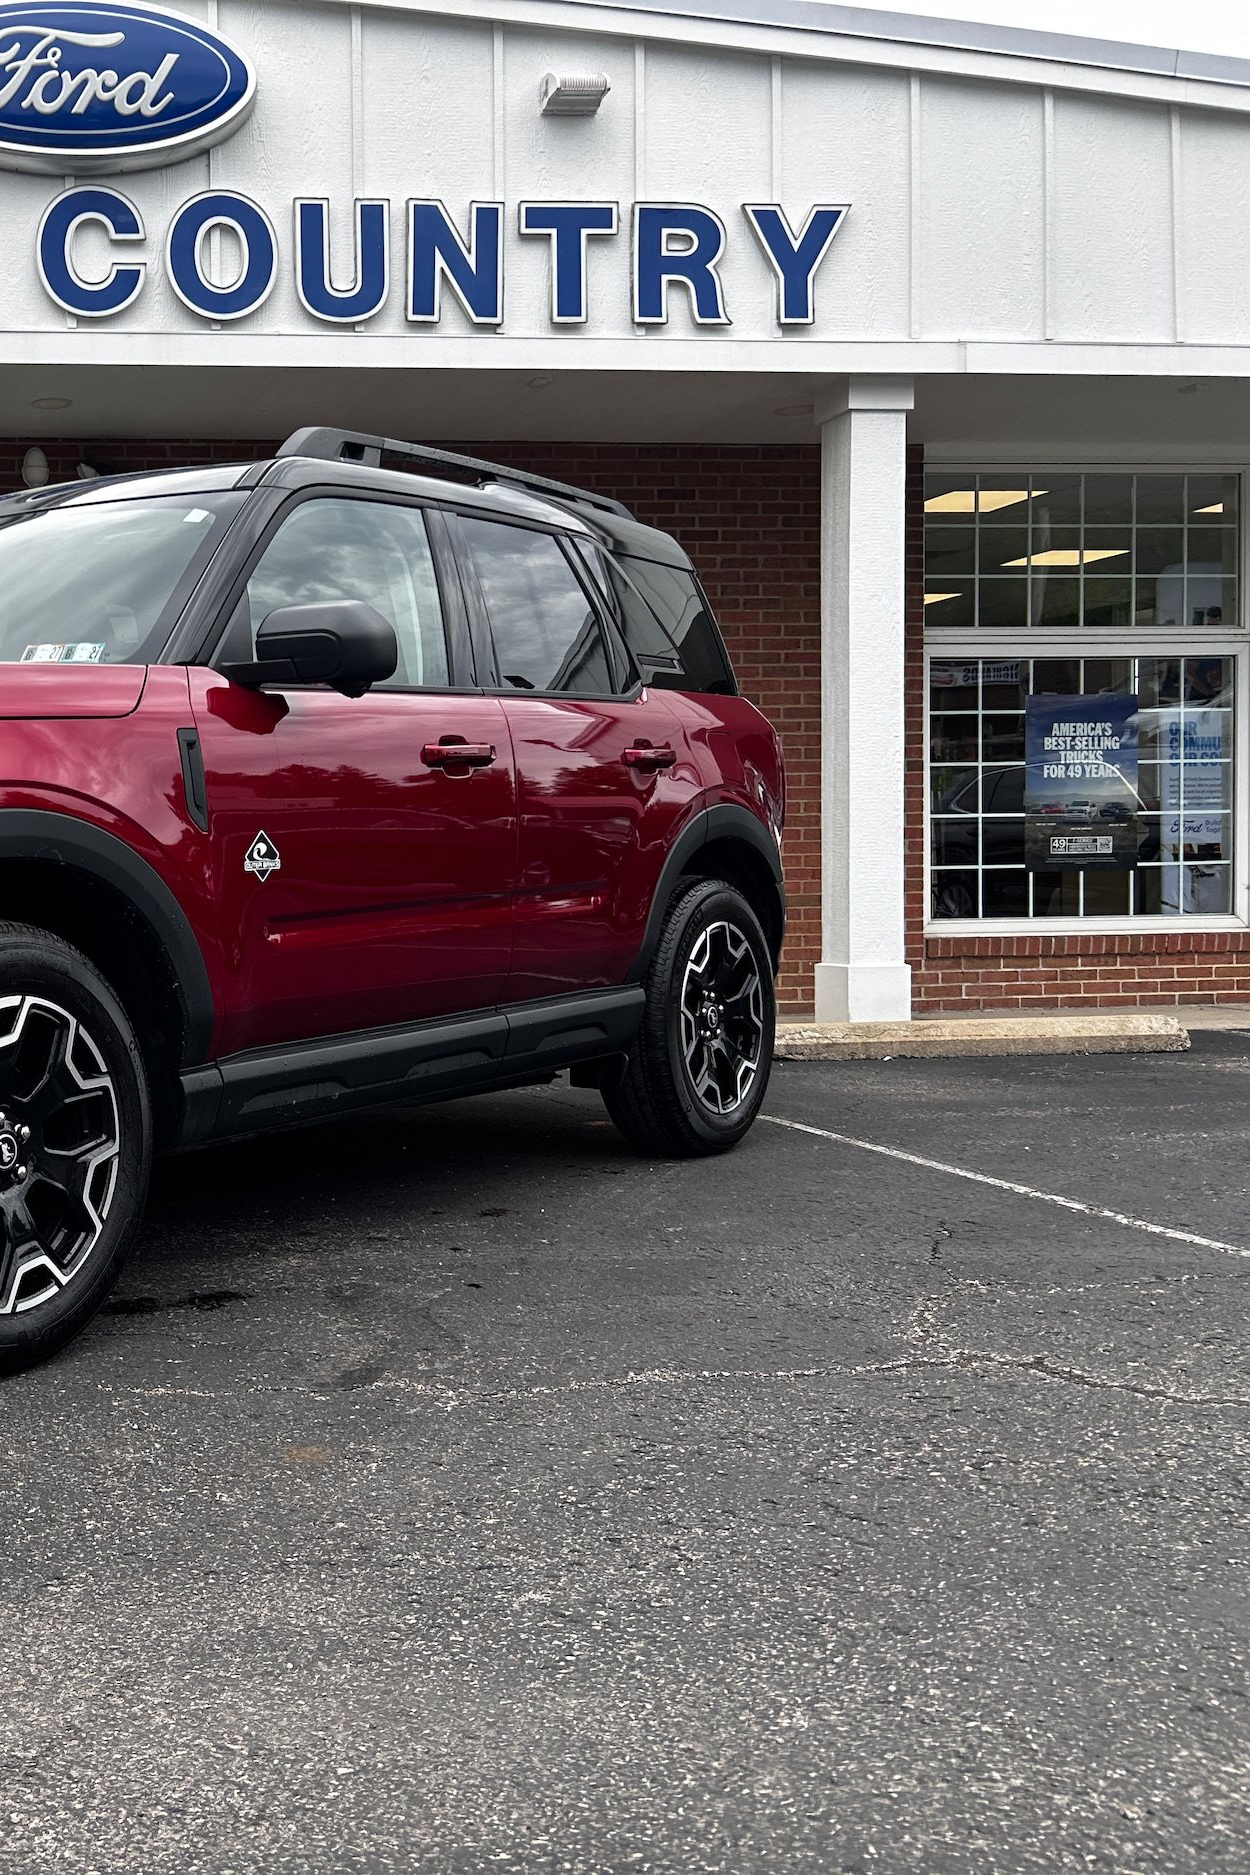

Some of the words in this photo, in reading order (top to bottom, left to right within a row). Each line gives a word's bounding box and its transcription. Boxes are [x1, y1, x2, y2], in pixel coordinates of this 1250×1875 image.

[36, 185, 851, 326] COUNTRY
[1051, 722, 1112, 736] AMERICA'S
[1043, 736, 1120, 750] BEST-SELLING
[1059, 750, 1103, 763] TRUCKS
[1043, 764, 1064, 778] FOR
[1066, 764, 1082, 778] 49
[1084, 764, 1120, 778] YEARS
[1052, 839, 1066, 848] 49
